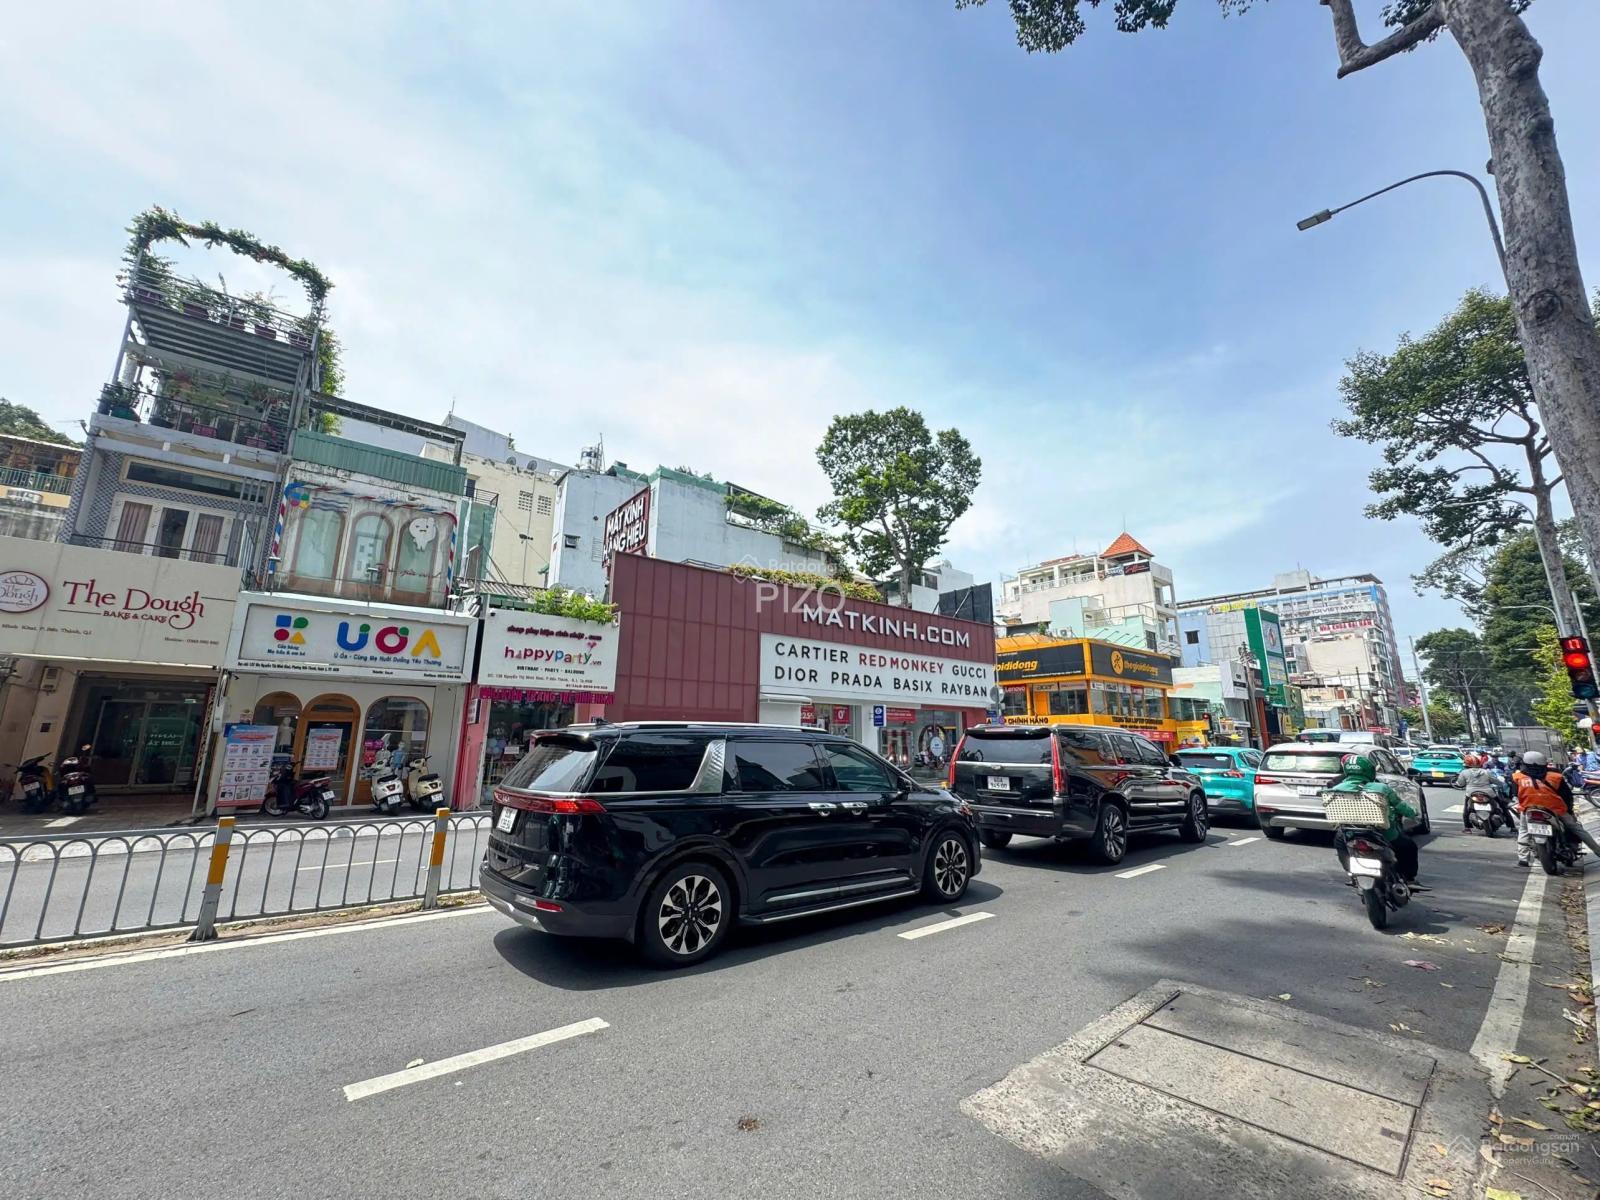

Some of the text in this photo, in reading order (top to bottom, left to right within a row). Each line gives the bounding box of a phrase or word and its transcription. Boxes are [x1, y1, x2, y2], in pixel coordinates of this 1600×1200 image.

[63, 579, 116, 608] The
[123, 588, 204, 630] Dough
[103, 610, 130, 620] BAKE
[141, 614, 167, 624] CAKE
[803, 603, 970, 648] MATKINH.COM
[775, 642, 849, 664] CARTIER
[952, 664, 987, 680] GUCCI
[774, 665, 988, 697] DIOR PRADA BASIX RAYBAN
[1345, 763, 1361, 772] Grab
